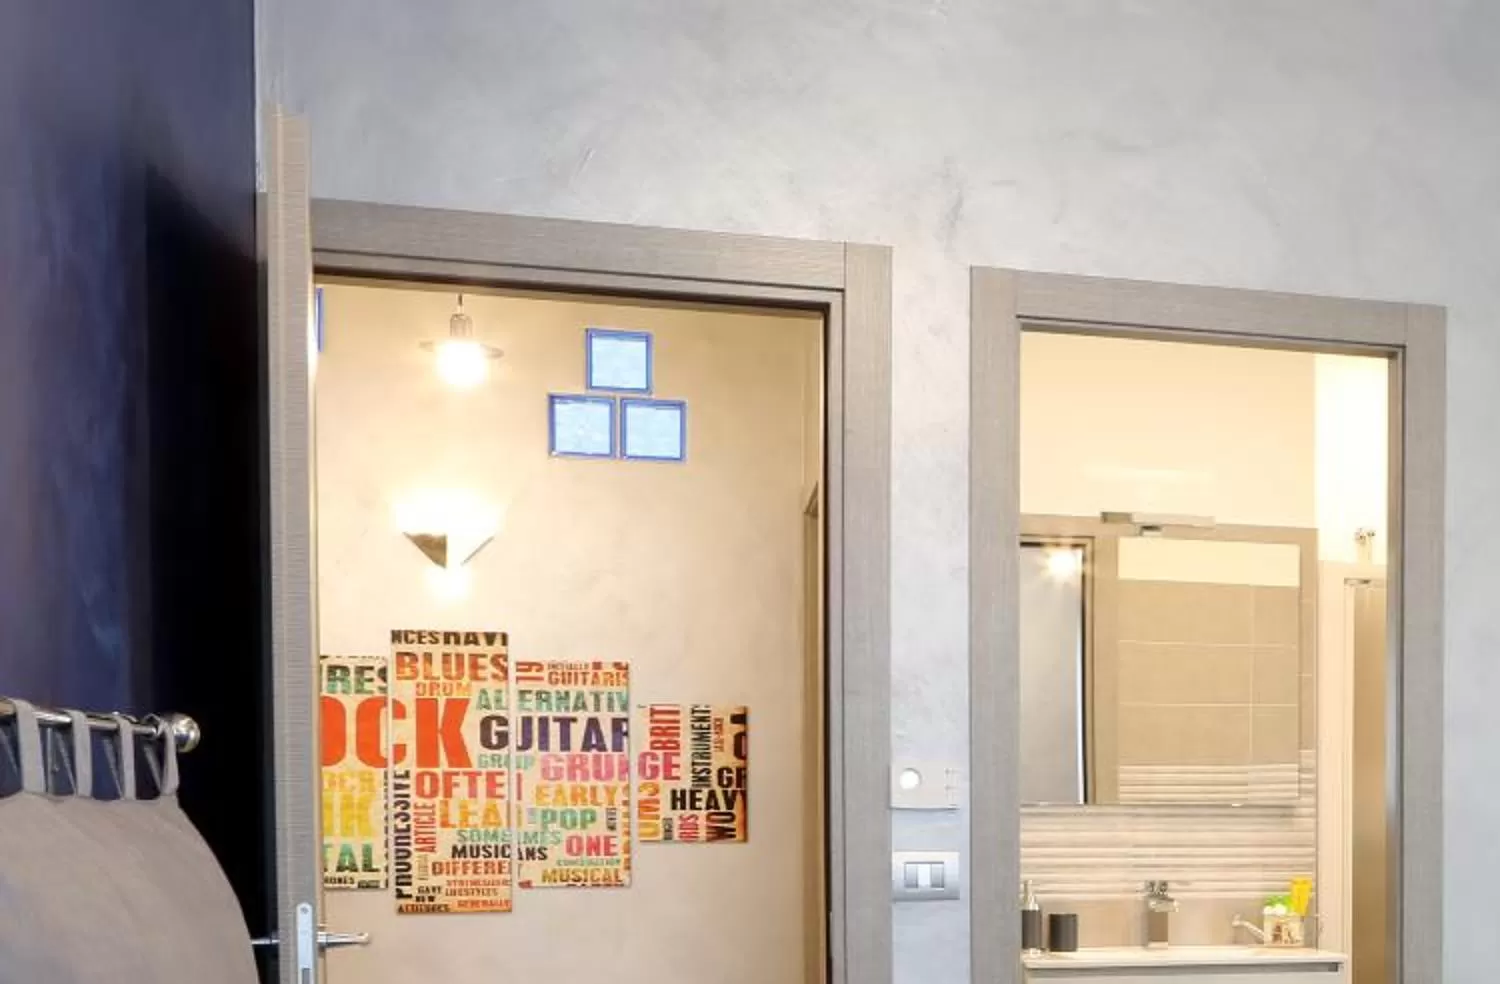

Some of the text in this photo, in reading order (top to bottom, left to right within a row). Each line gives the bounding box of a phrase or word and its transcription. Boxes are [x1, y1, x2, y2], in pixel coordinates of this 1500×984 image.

[396, 652, 508, 681] BLUES
[535, 784, 617, 806] EARLY
[414, 802, 436, 853] ARTICLE
[542, 808, 597, 830] POP
[566, 835, 618, 856] ONE
[542, 868, 623, 882] MUSICAL
